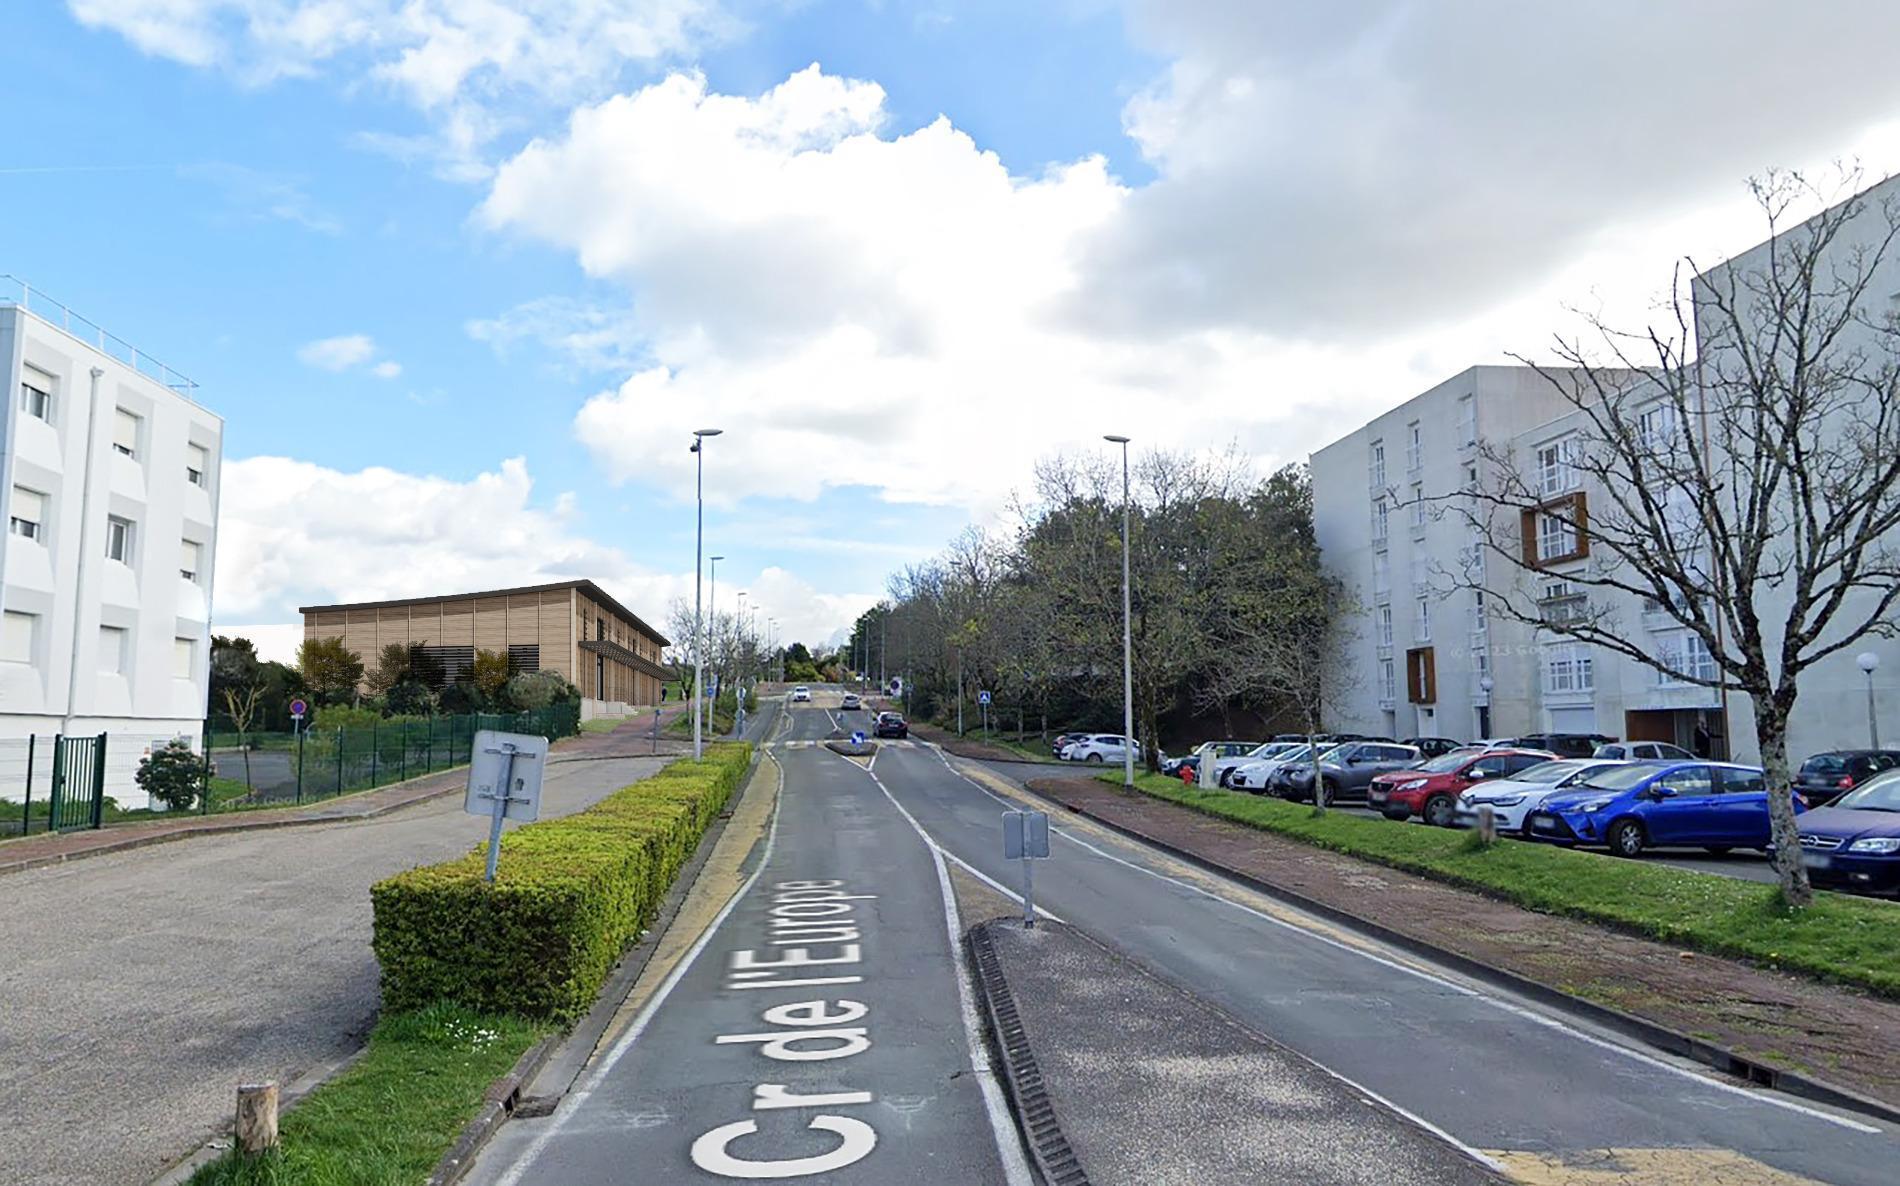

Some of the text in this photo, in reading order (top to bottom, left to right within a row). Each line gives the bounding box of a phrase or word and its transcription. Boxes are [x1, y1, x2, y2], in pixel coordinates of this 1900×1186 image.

[690, 879, 880, 1178] Cr de l'Europe
